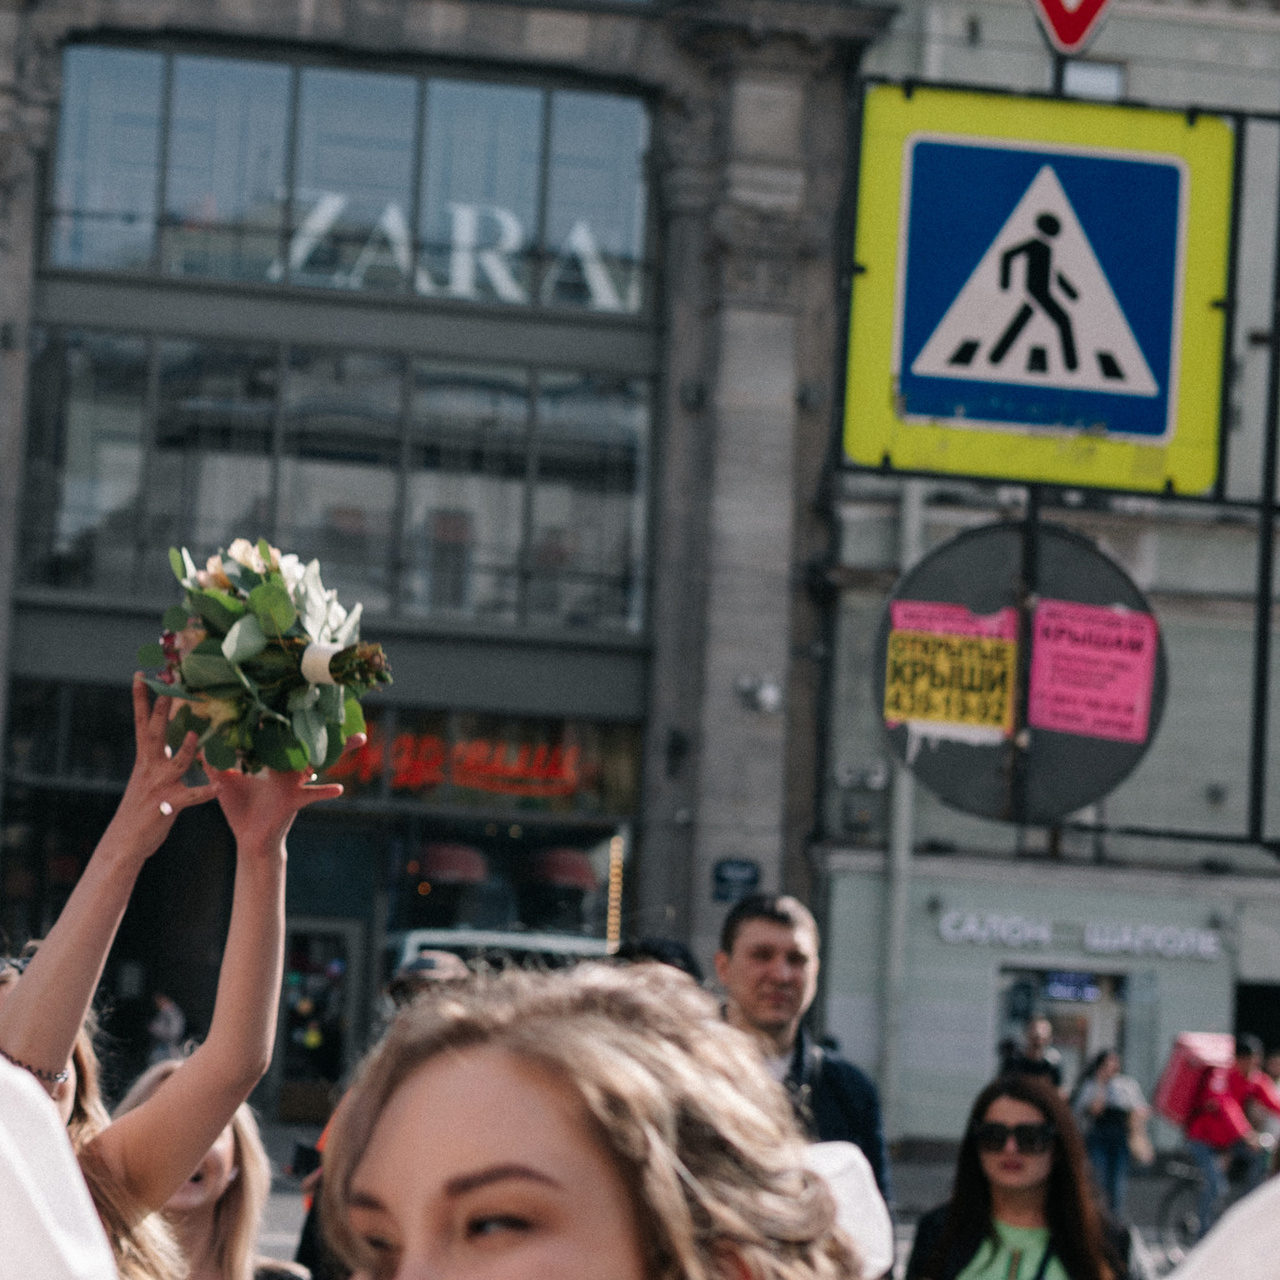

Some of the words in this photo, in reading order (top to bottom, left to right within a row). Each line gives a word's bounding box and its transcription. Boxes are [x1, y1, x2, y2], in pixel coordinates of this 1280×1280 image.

[267, 190, 632, 313] ZARA
[889, 659, 1008, 694] КРЫШИ
[939, 911, 1052, 946] САЛОН
